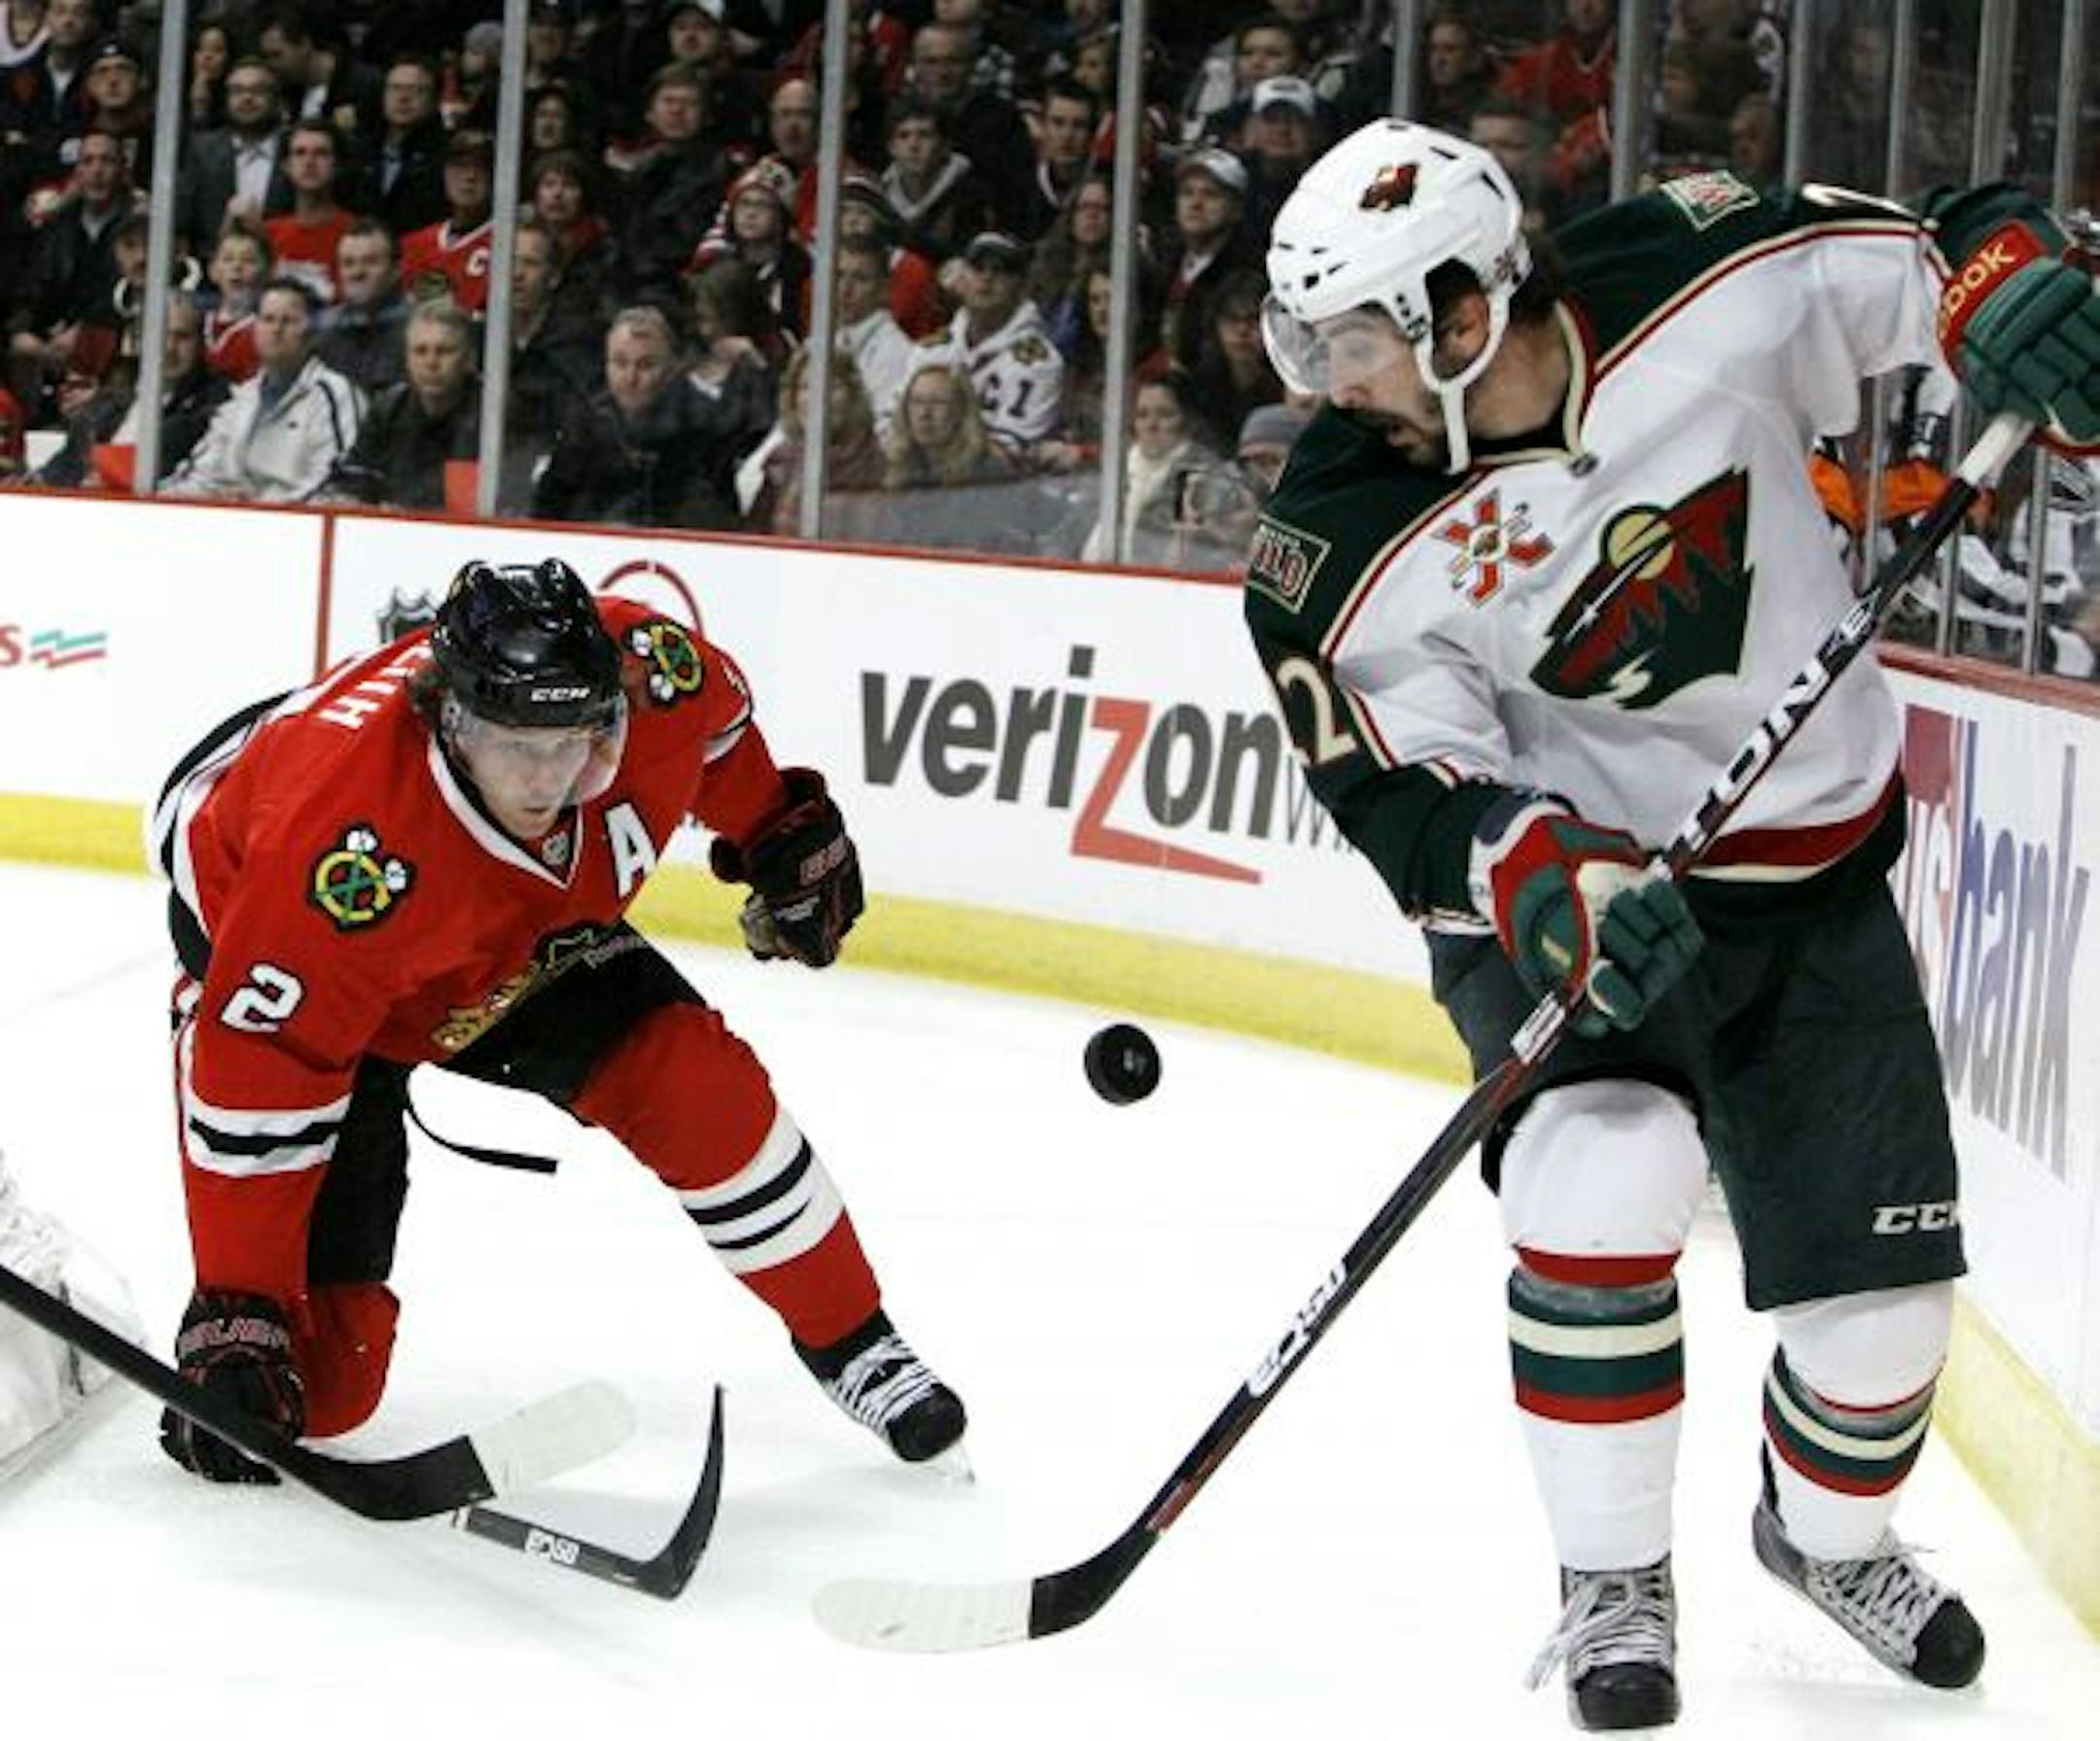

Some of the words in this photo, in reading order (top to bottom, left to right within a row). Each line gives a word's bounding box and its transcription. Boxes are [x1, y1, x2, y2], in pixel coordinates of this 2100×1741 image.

[1277, 656, 1358, 764] 2
[604, 801, 657, 897] A
[221, 963, 302, 1033] 2
